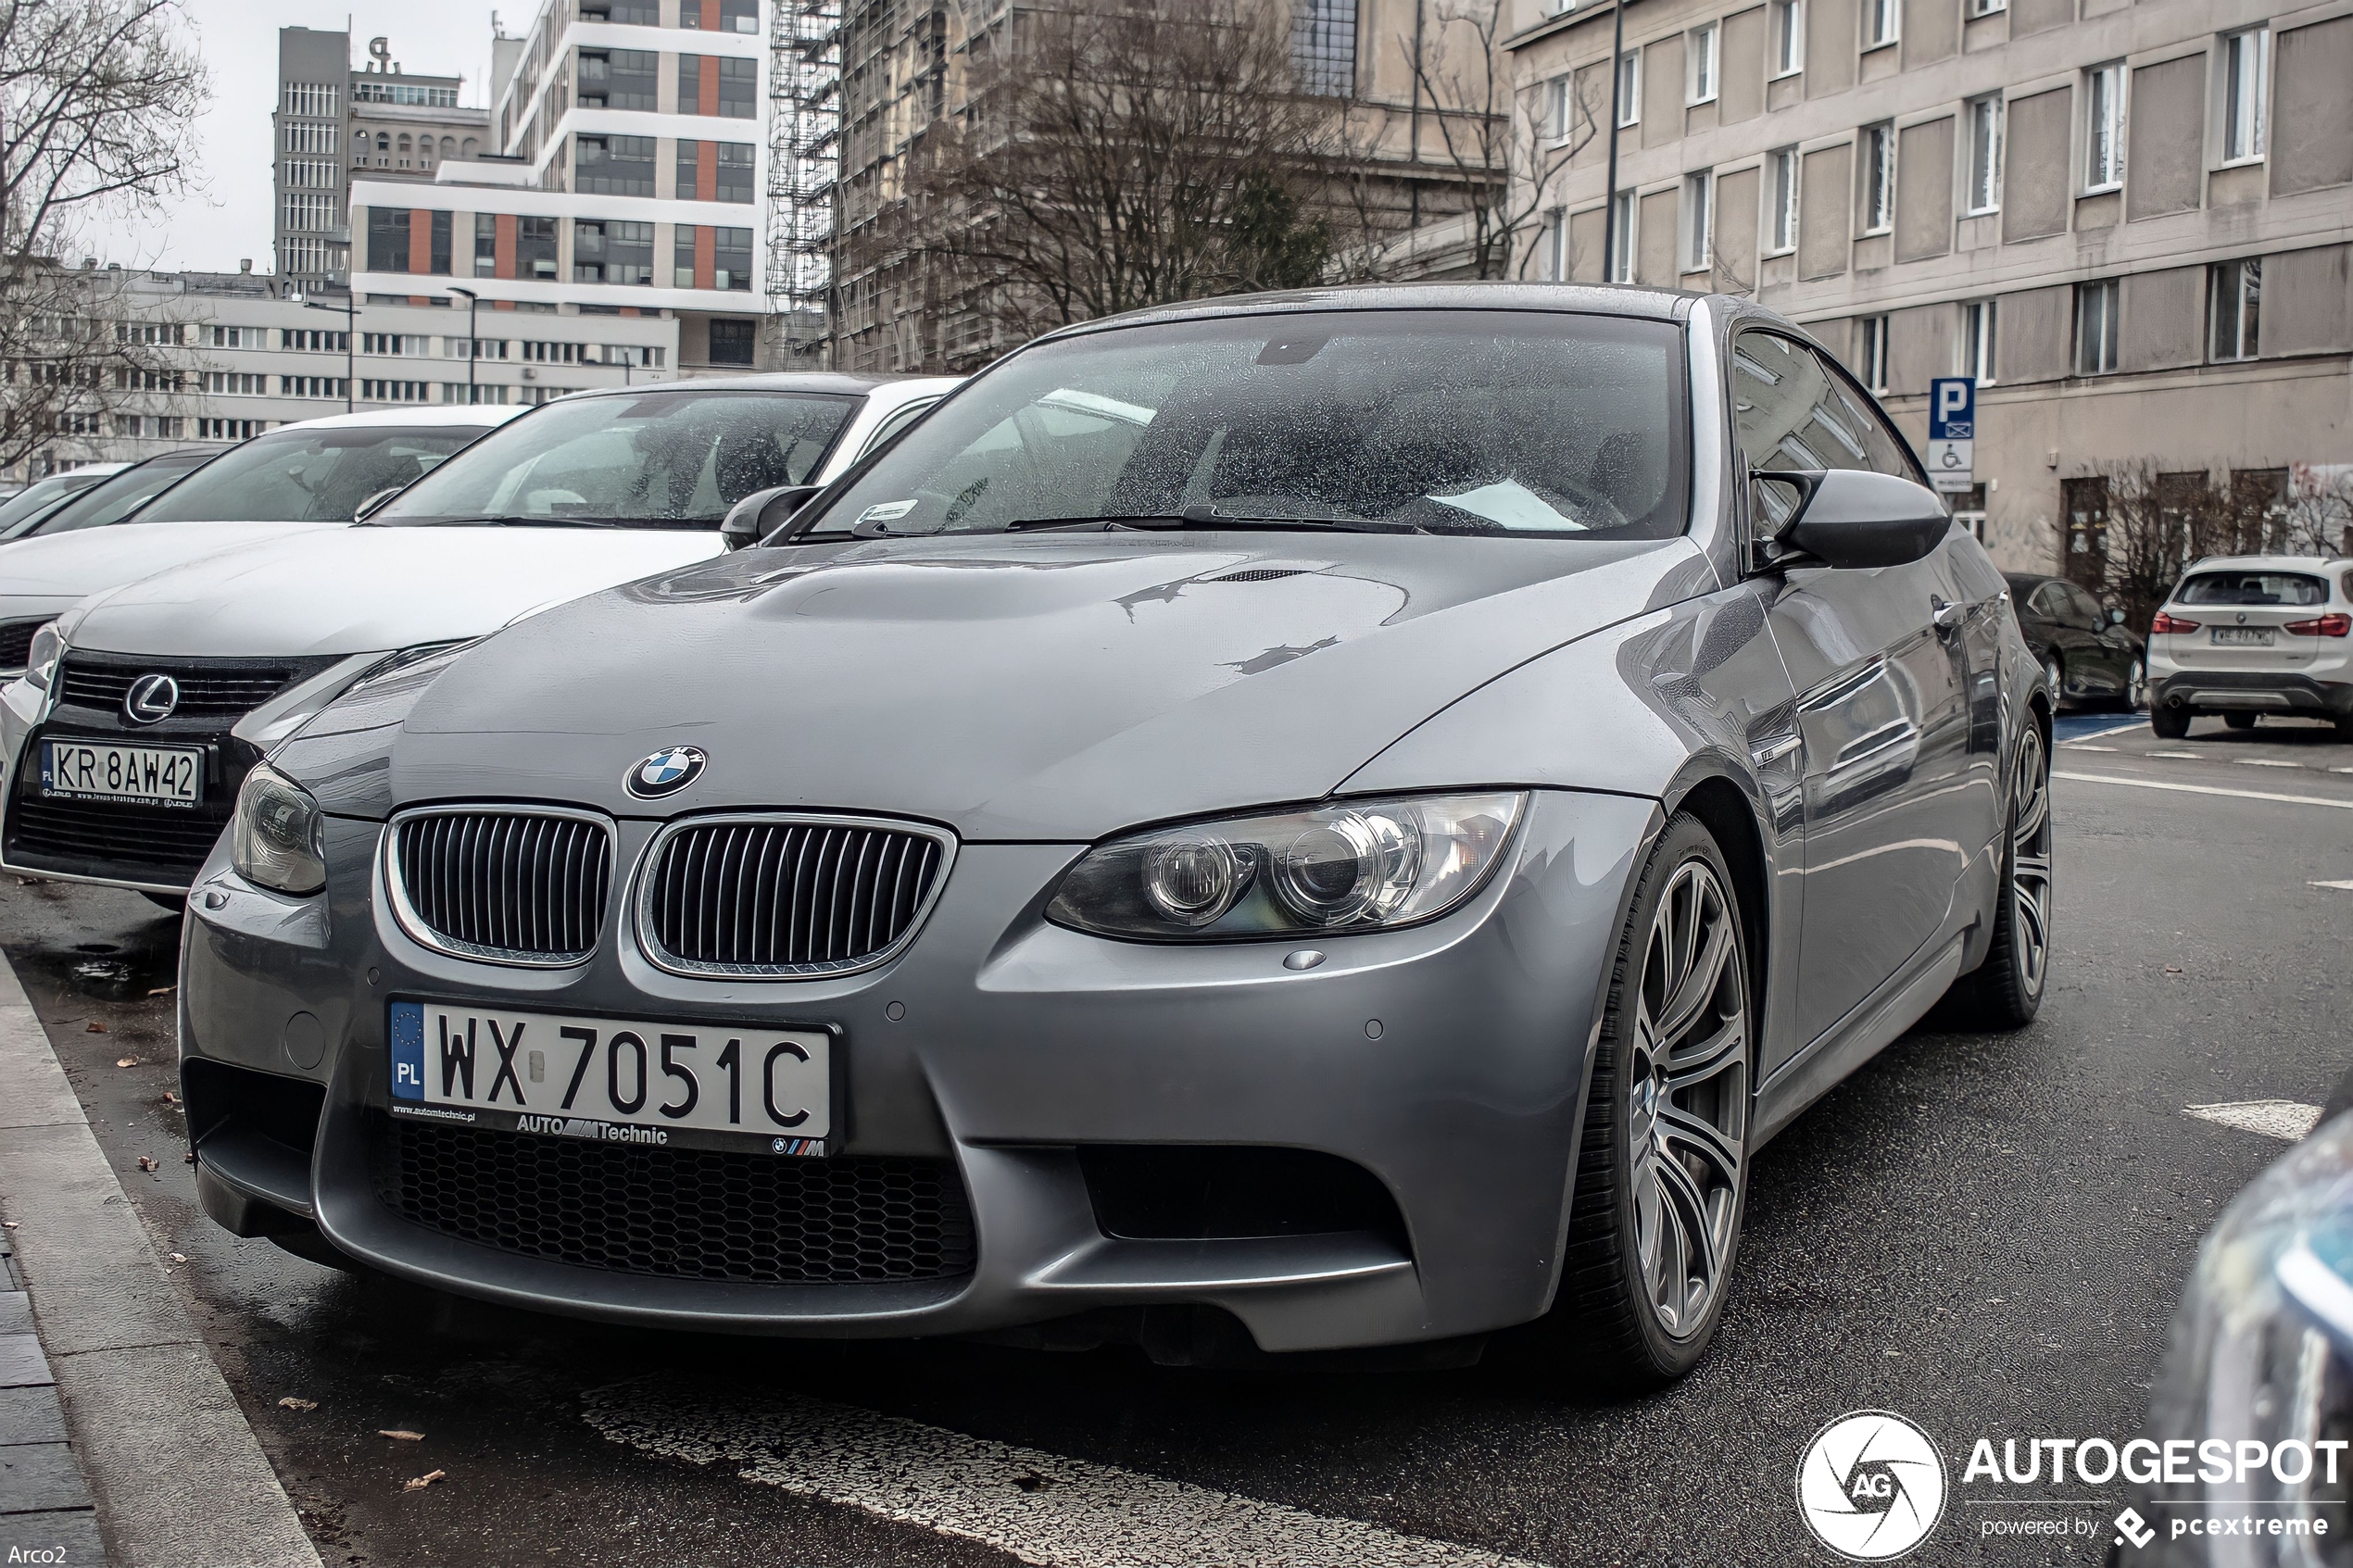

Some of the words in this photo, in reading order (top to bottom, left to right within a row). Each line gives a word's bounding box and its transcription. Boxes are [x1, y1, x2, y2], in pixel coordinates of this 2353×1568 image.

[1938, 383, 1967, 422] P
[57, 746, 95, 788] KR
[107, 751, 193, 797] 8AW42
[397, 1062, 420, 1085] PL
[438, 1014, 526, 1105] WX
[560, 1025, 811, 1128] 7051C
